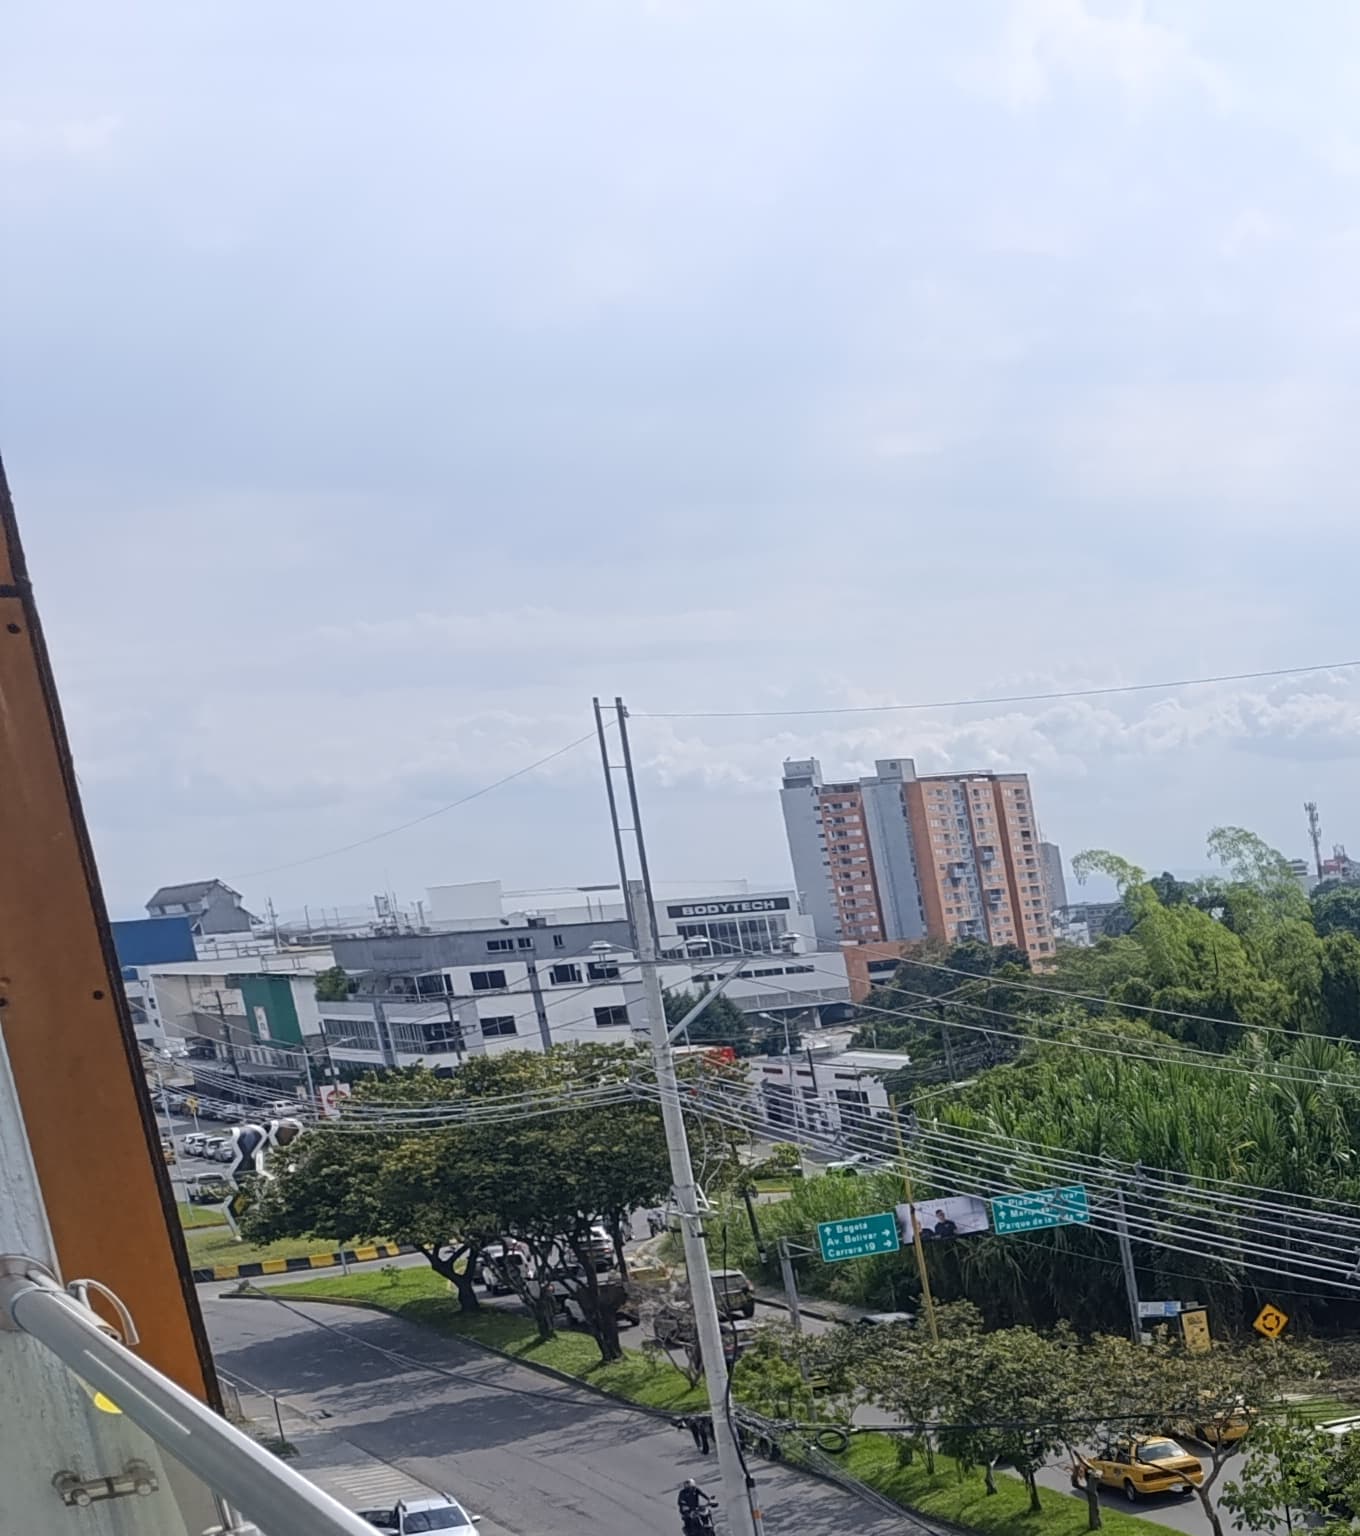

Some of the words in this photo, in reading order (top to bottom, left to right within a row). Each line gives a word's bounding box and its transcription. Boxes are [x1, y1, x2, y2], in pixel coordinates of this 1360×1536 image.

[682, 900, 775, 916] BODYTECH
[835, 1221, 868, 1234] Bogotá
[998, 1218, 1031, 1231] Parque
[1033, 1218, 1043, 1226] de
[1044, 1216, 1053, 1224] la
[827, 1246, 863, 1258] Carrera
